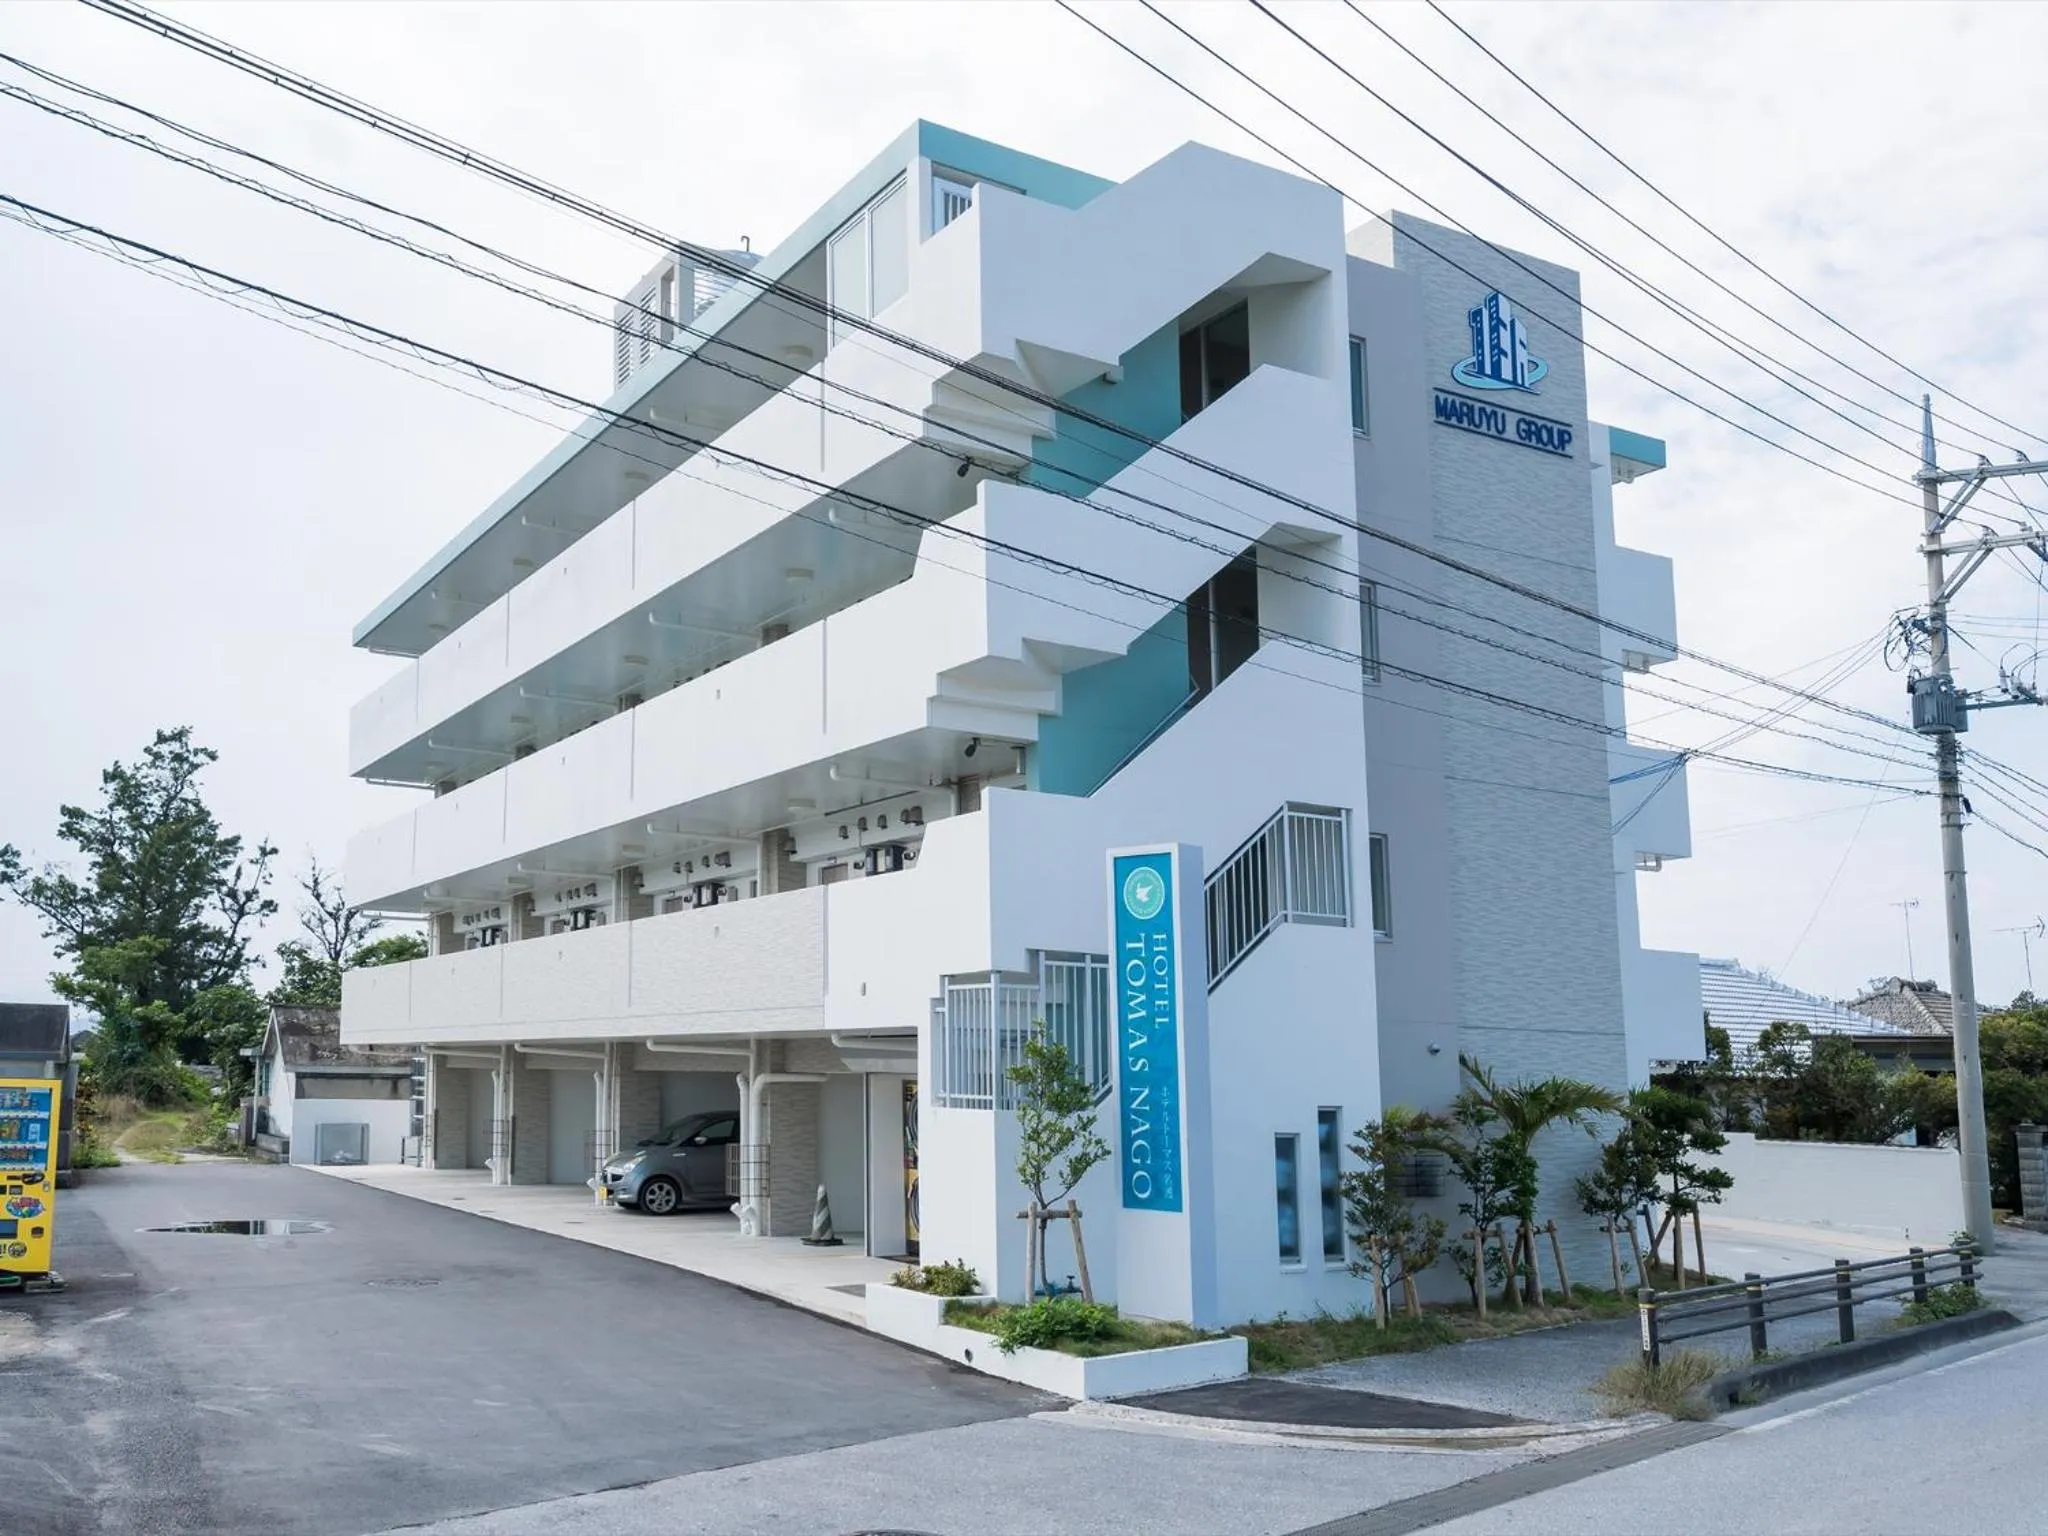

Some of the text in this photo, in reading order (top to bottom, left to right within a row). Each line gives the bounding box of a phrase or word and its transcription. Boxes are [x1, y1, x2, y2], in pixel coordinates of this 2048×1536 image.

[1434, 394, 1573, 451] MARUYU GROUP
[1126, 933, 1149, 1071] TOMAS
[1152, 933, 1169, 1029] HOTEL
[1130, 1086, 1152, 1199] NAGO
